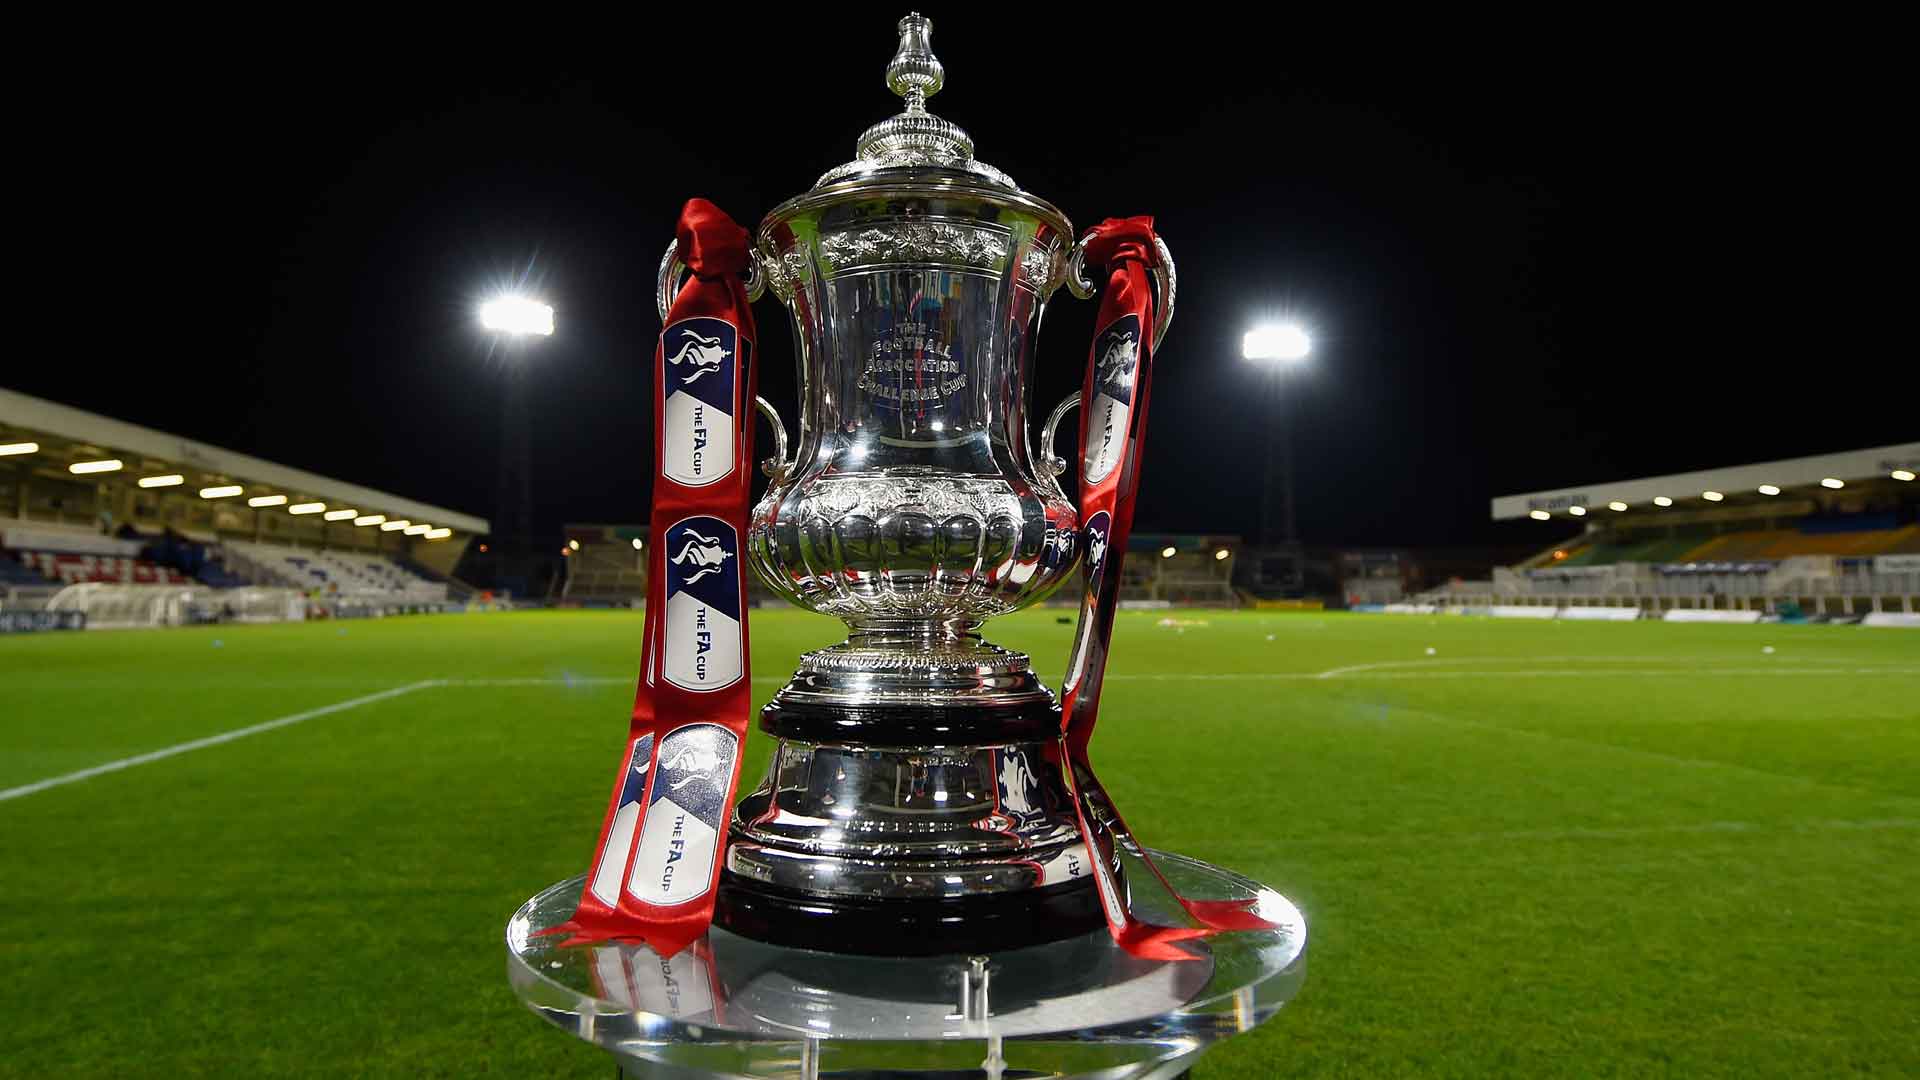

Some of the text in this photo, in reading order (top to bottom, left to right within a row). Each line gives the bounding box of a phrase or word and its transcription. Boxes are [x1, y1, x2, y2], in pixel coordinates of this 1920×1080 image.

[897, 322, 927, 335] THE
[871, 337, 952, 360] FOOTBALL
[866, 358, 960, 373] ASSOCIATION
[856, 372, 968, 401] CHALLENGE CUP
[693, 404, 707, 475] THE FA CUP
[696, 607, 711, 680] THE FA CUP
[661, 814, 685, 892] THE FA CUP
